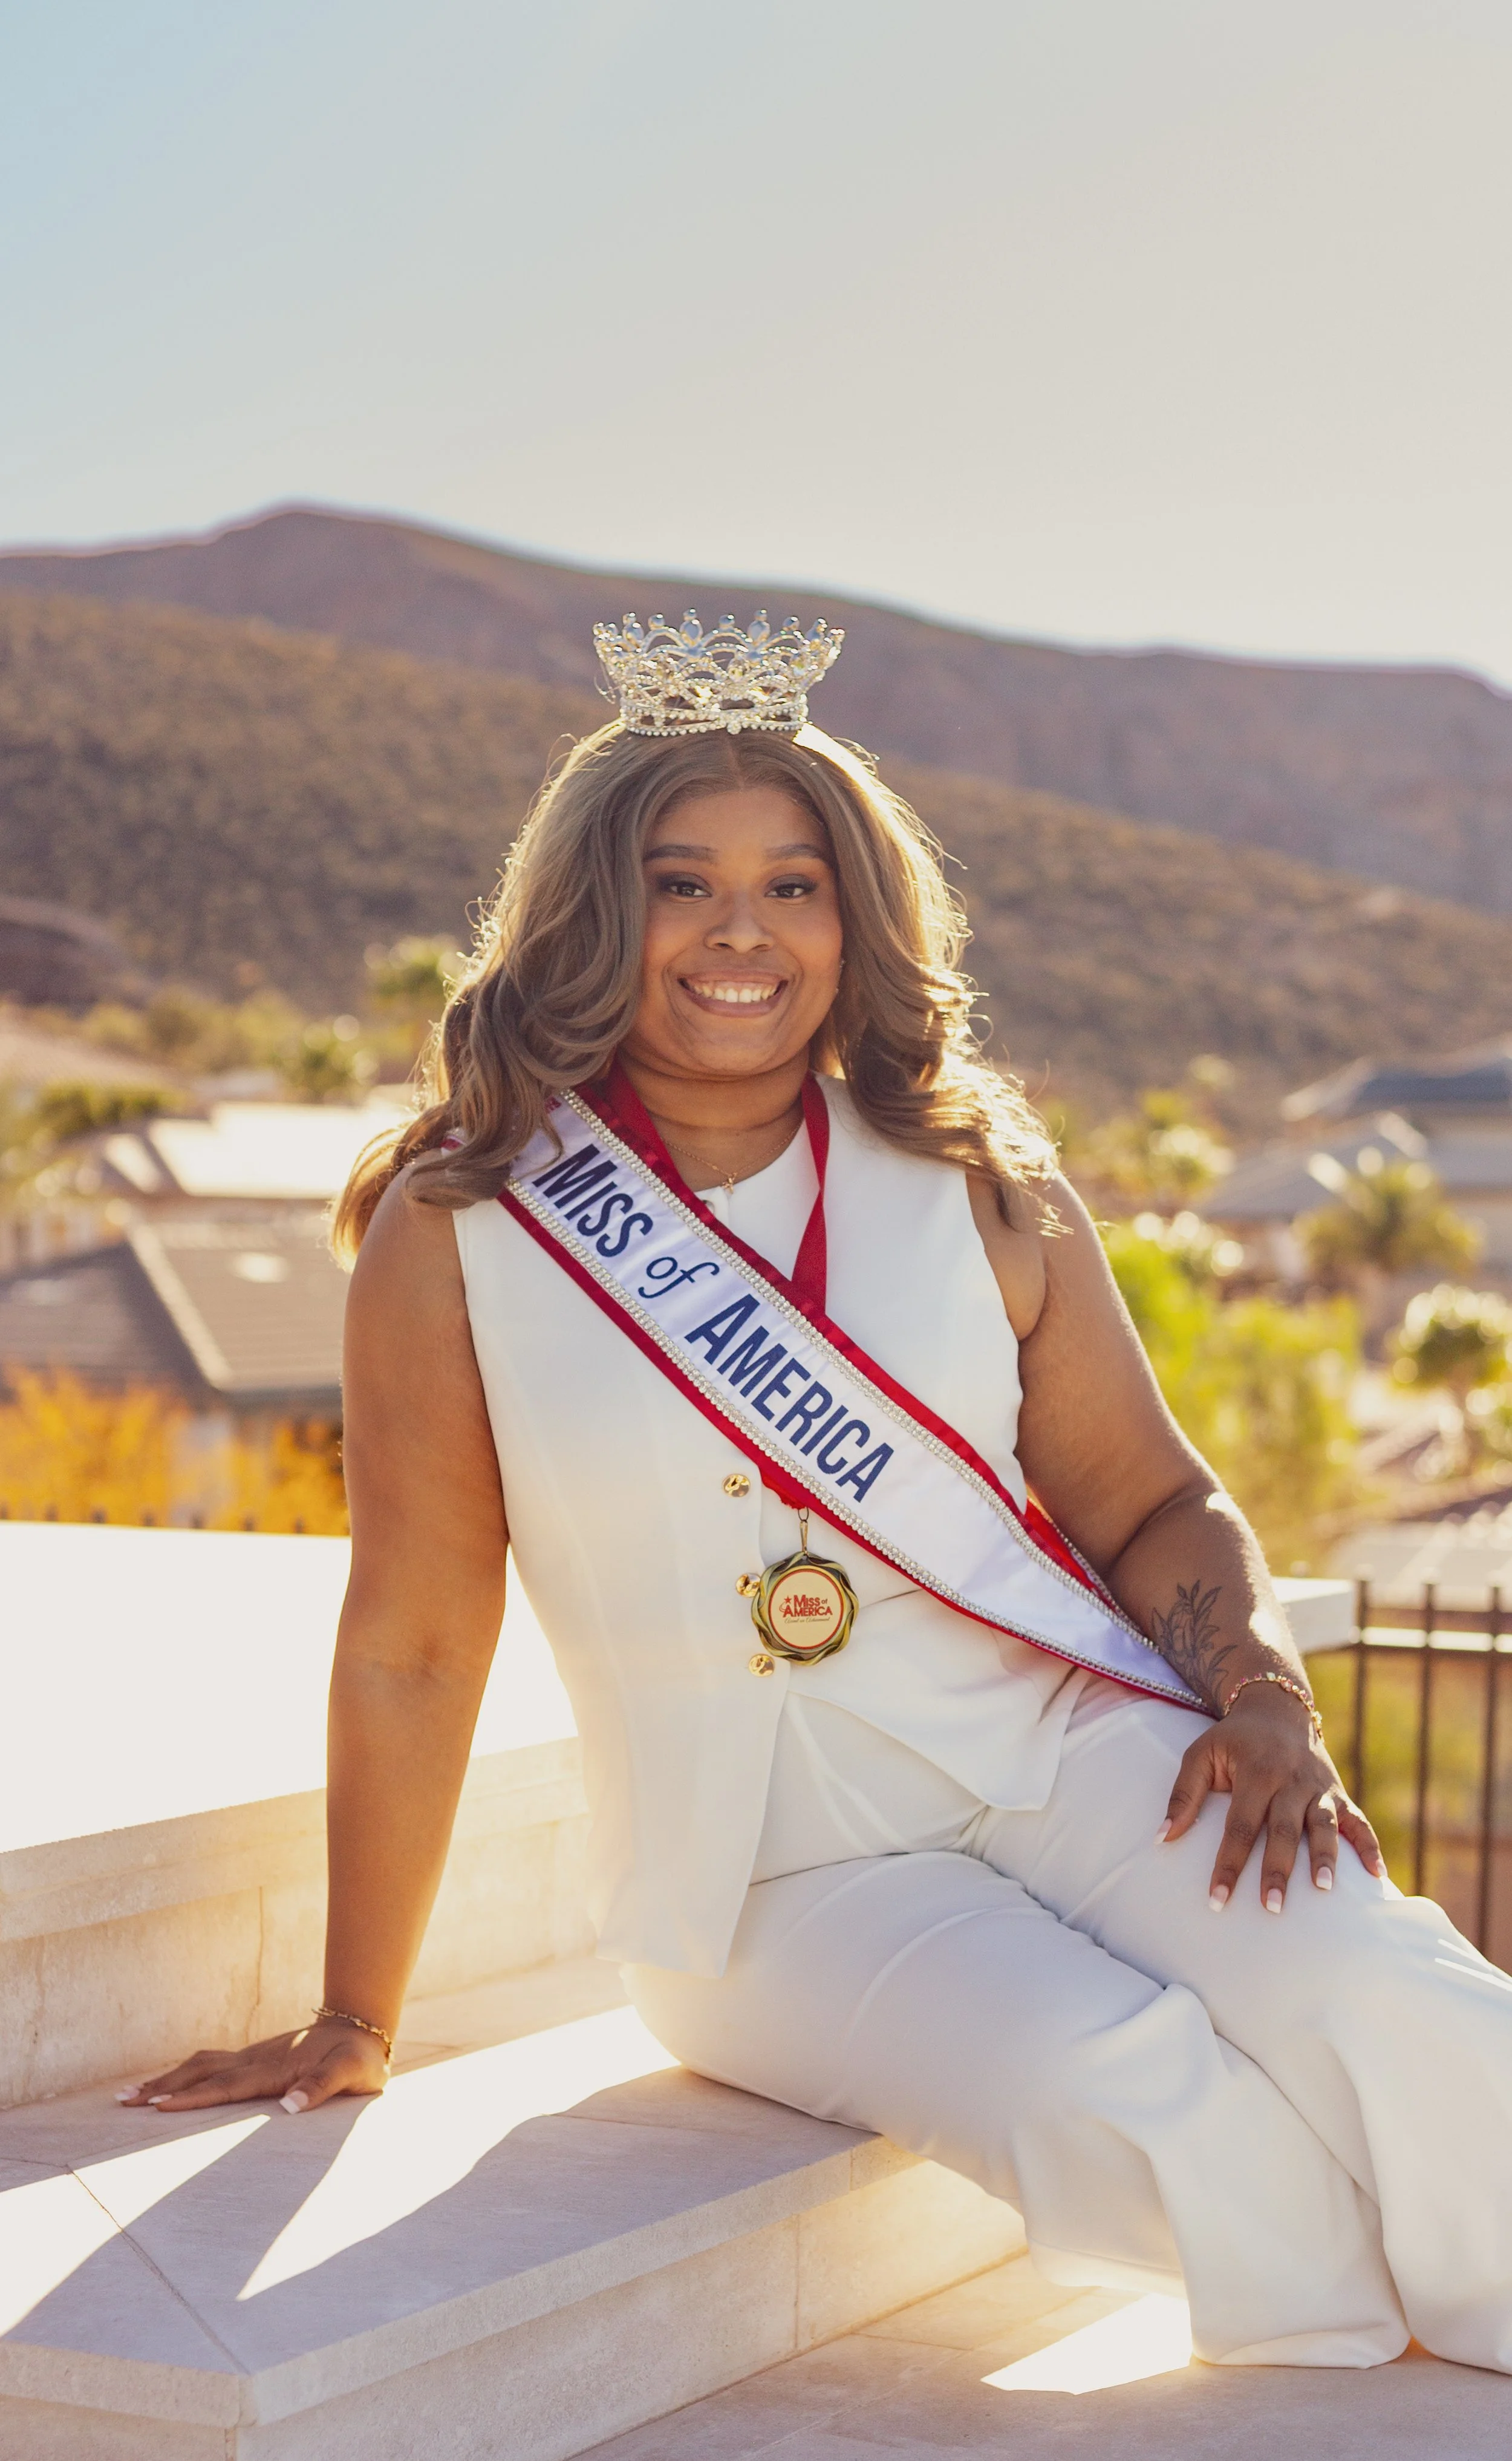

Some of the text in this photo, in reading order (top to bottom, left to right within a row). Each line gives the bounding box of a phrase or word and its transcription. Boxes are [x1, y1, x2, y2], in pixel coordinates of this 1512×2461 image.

[532, 1143, 895, 1503] MISS of AMERICA
[783, 1604, 833, 1618] AMERICA
